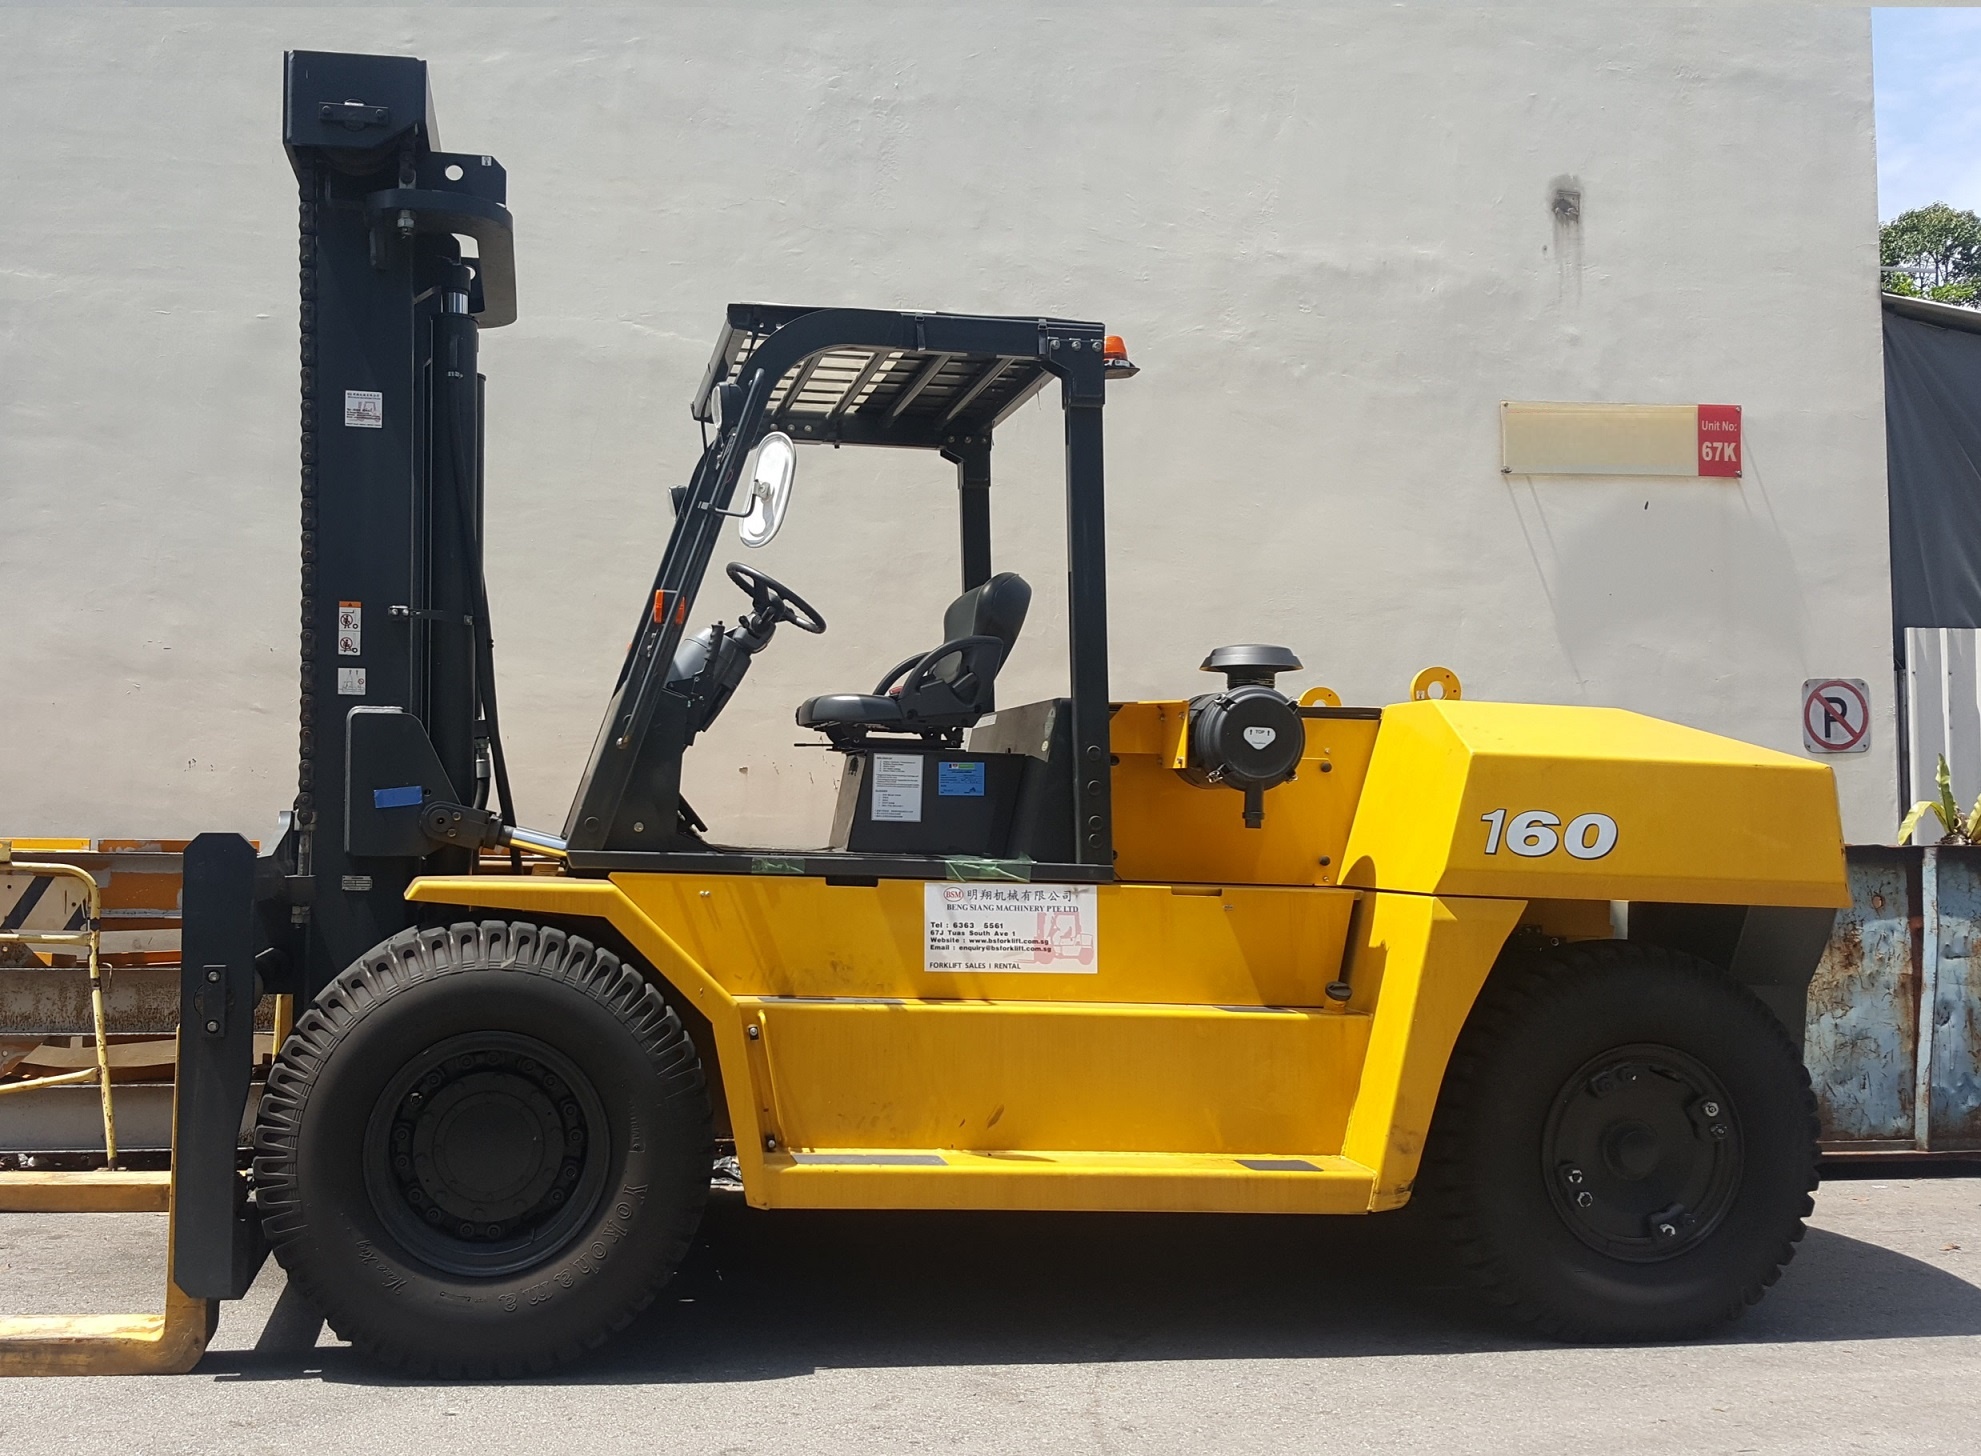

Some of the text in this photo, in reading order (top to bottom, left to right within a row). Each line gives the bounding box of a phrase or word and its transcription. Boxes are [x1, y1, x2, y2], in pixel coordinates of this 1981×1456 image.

[1702, 421, 1737, 432] Unit No:
[1702, 441, 1736, 462] 67K
[1824, 697, 1847, 738] P
[1480, 808, 1618, 860] 160
[967, 888, 1072, 902] 明翔机械有限公司
[498, 1182, 648, 1312] Yokohama
